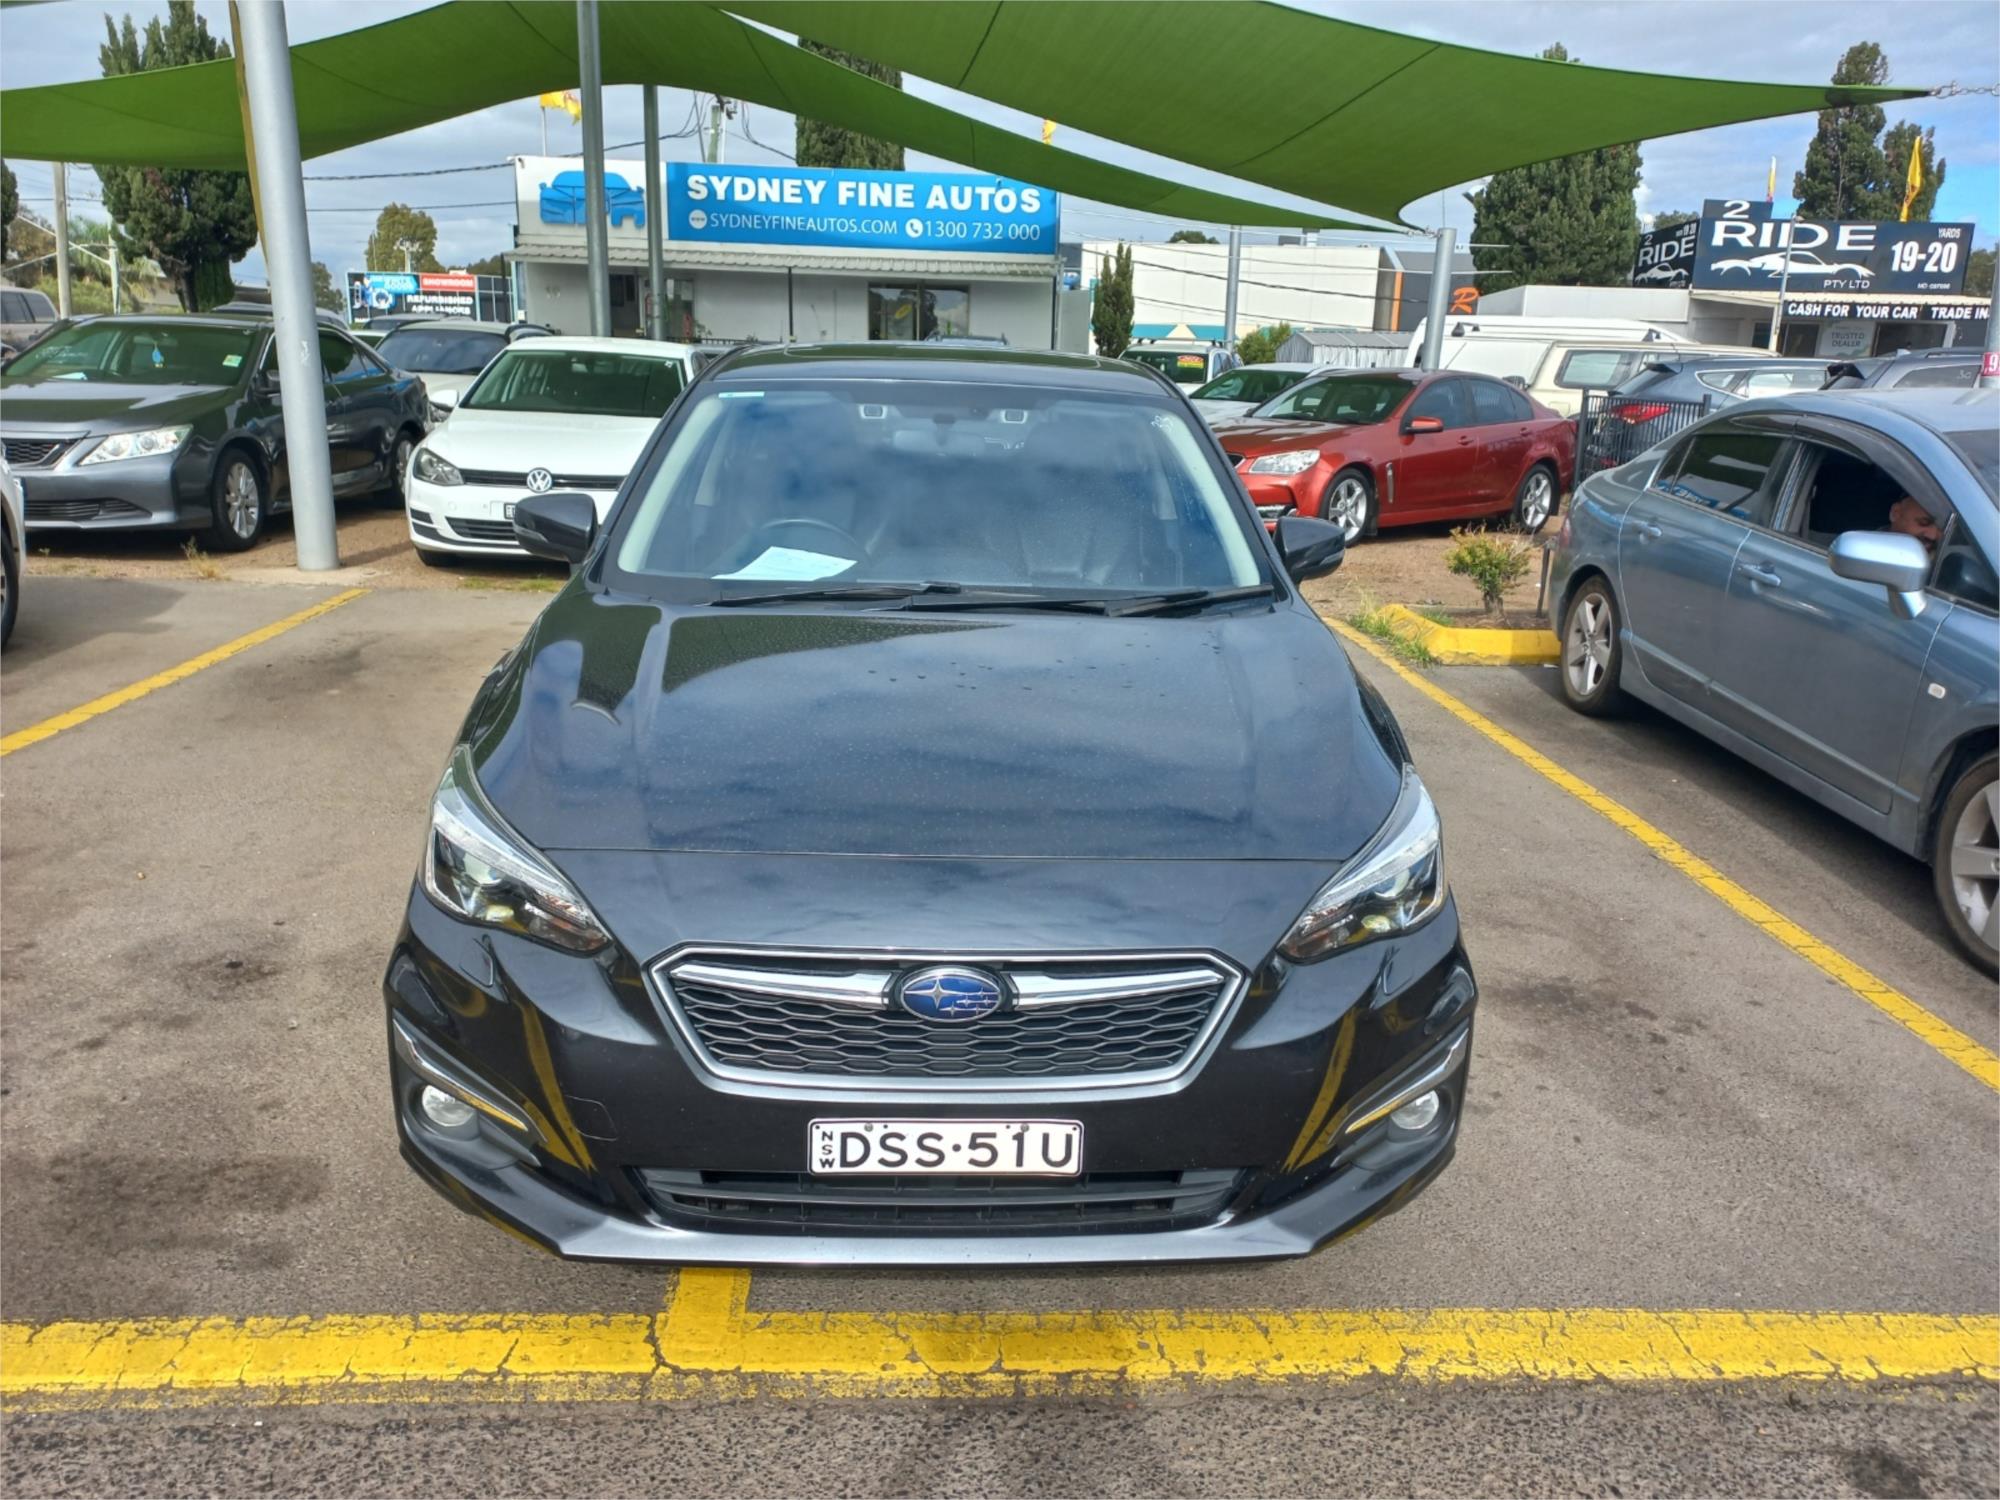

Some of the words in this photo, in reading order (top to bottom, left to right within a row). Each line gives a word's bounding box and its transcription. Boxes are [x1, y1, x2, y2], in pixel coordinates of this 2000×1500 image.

[687, 174, 827, 205] SYDNEY
[838, 181, 915, 208] FINE
[925, 184, 1041, 214] AUTOS
[1722, 200, 1750, 219] 2
[710, 213, 898, 234] SYDNEYFINEAUTOS.COM
[925, 220, 967, 238] 1300
[972, 222, 1003, 239] 732
[1008, 223, 1040, 240] 000
[1711, 220, 1877, 251] RIDE
[1937, 227, 1961, 239] YARDS
[1644, 234, 1653, 246] 2
[1638, 235, 1696, 267] RIDE
[1891, 241, 1958, 273] 19-20
[1823, 279, 1847, 290] PTY
[1848, 279, 1871, 290] LTD
[406, 294, 473, 305] REFURBISHED
[1788, 302, 1822, 316] CASH
[1824, 304, 1850, 317] FOR
[1855, 305, 1889, 319] YOUR
[1892, 306, 1918, 320] CAR
[1931, 306, 1971, 320] TRADE
[1831, 340, 1861, 348] DEALER
